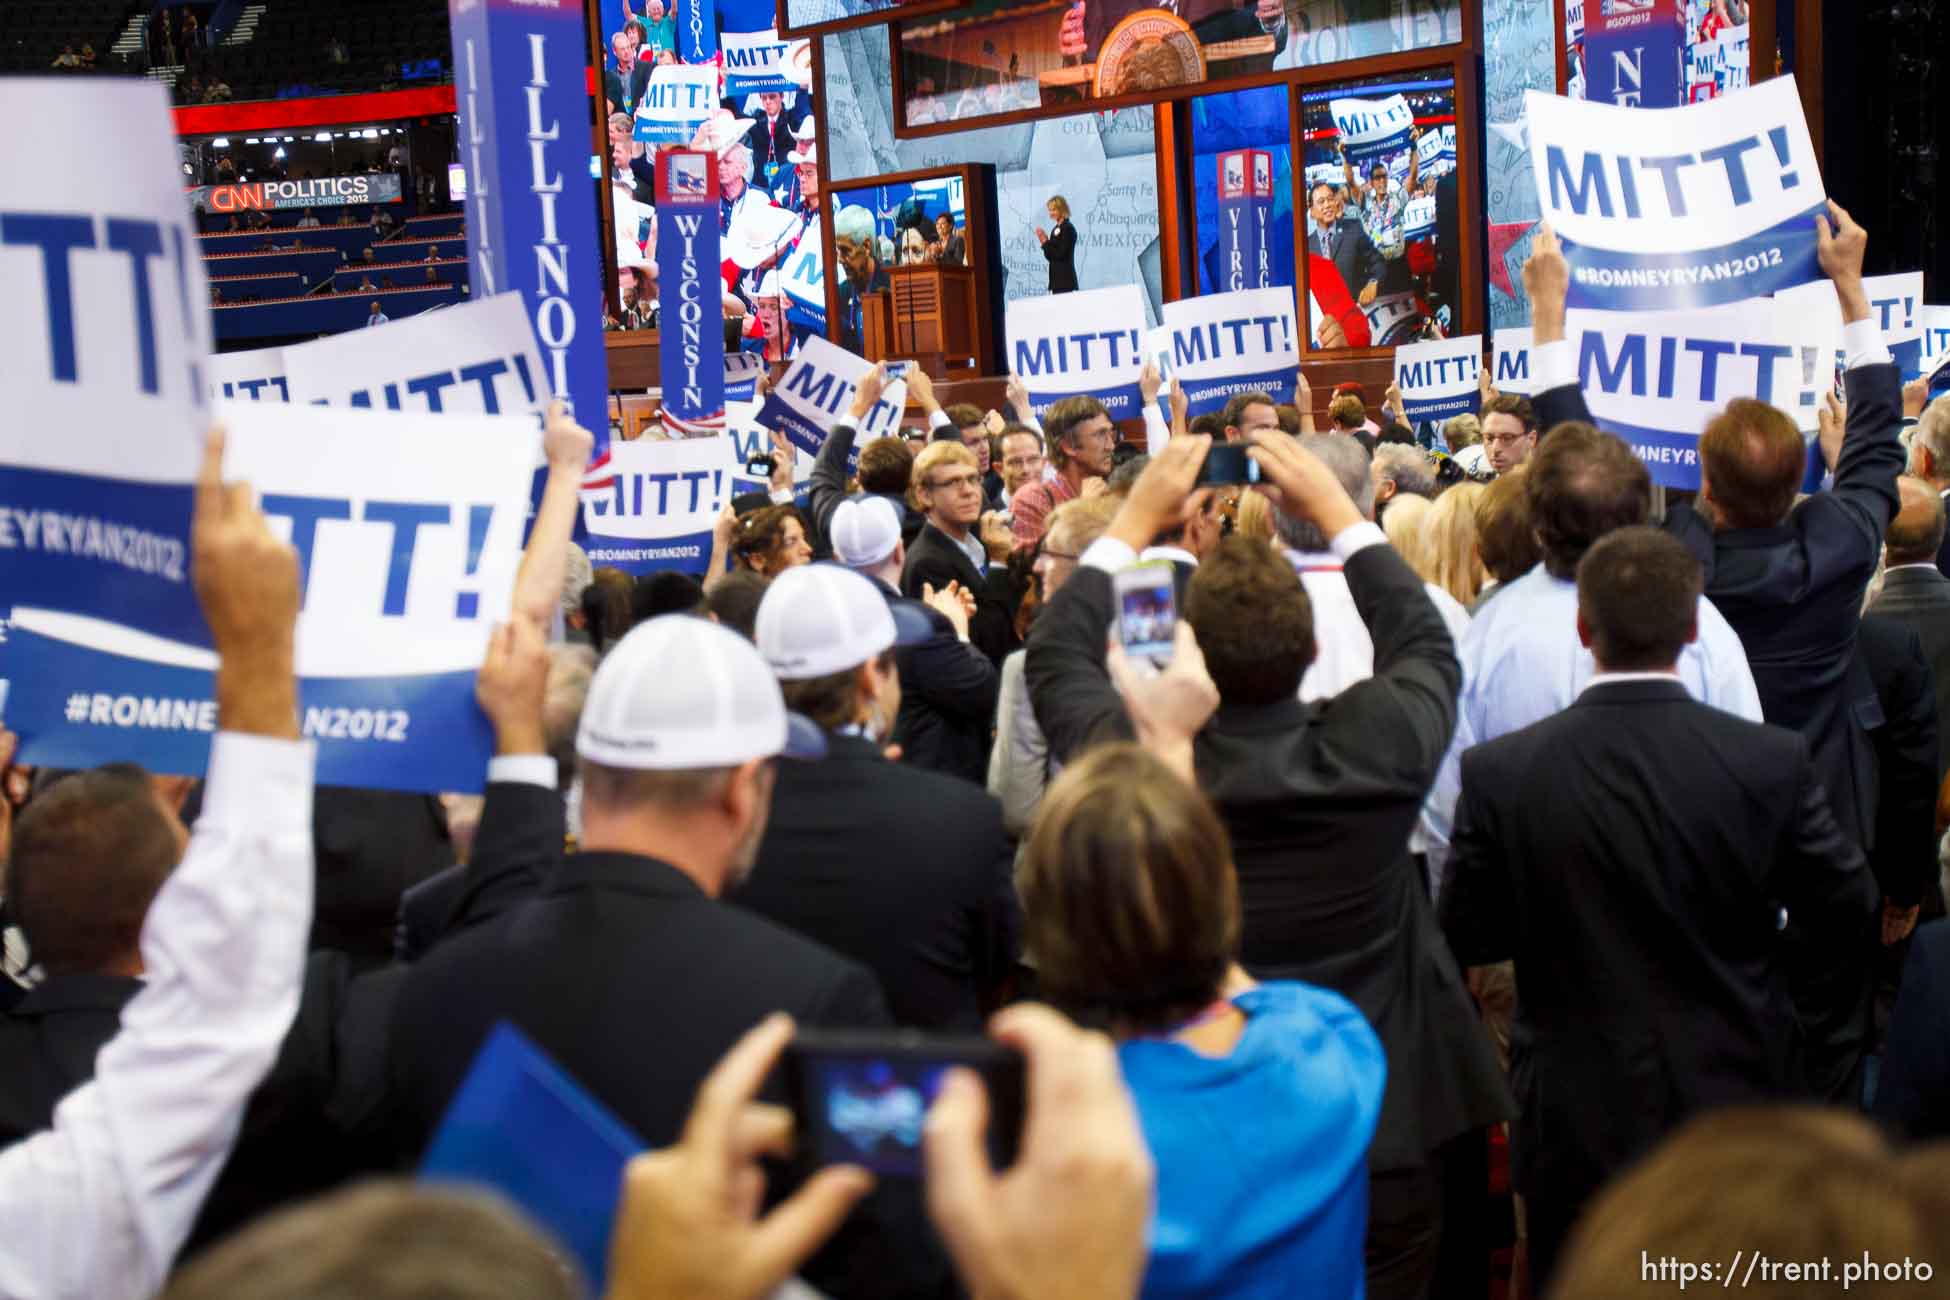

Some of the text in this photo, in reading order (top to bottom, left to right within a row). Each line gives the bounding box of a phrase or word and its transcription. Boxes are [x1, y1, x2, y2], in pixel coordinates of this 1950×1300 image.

[689, 0, 704, 58] SOTA
[726, 42, 793, 68] MITT
[211, 176, 369, 213] CNN POLITICS
[1546, 124, 1800, 219] MITT!
[274, 194, 369, 209] AMERICA'S CHOICE 2012
[1576, 247, 1784, 287] #ROMNEYRYAN2012
[674, 215, 704, 408] WISCONSIN
[1014, 328, 1141, 377] MITT!
[1172, 314, 1292, 368] MITT!
[1190, 380, 1283, 402] #ROMNEYRYAN2012
[1399, 354, 1477, 390] MITT!
[1578, 329, 1821, 406] MITT!
[785, 361, 899, 438] MIT!
[64, 693, 410, 741] #ROMNEN2012
